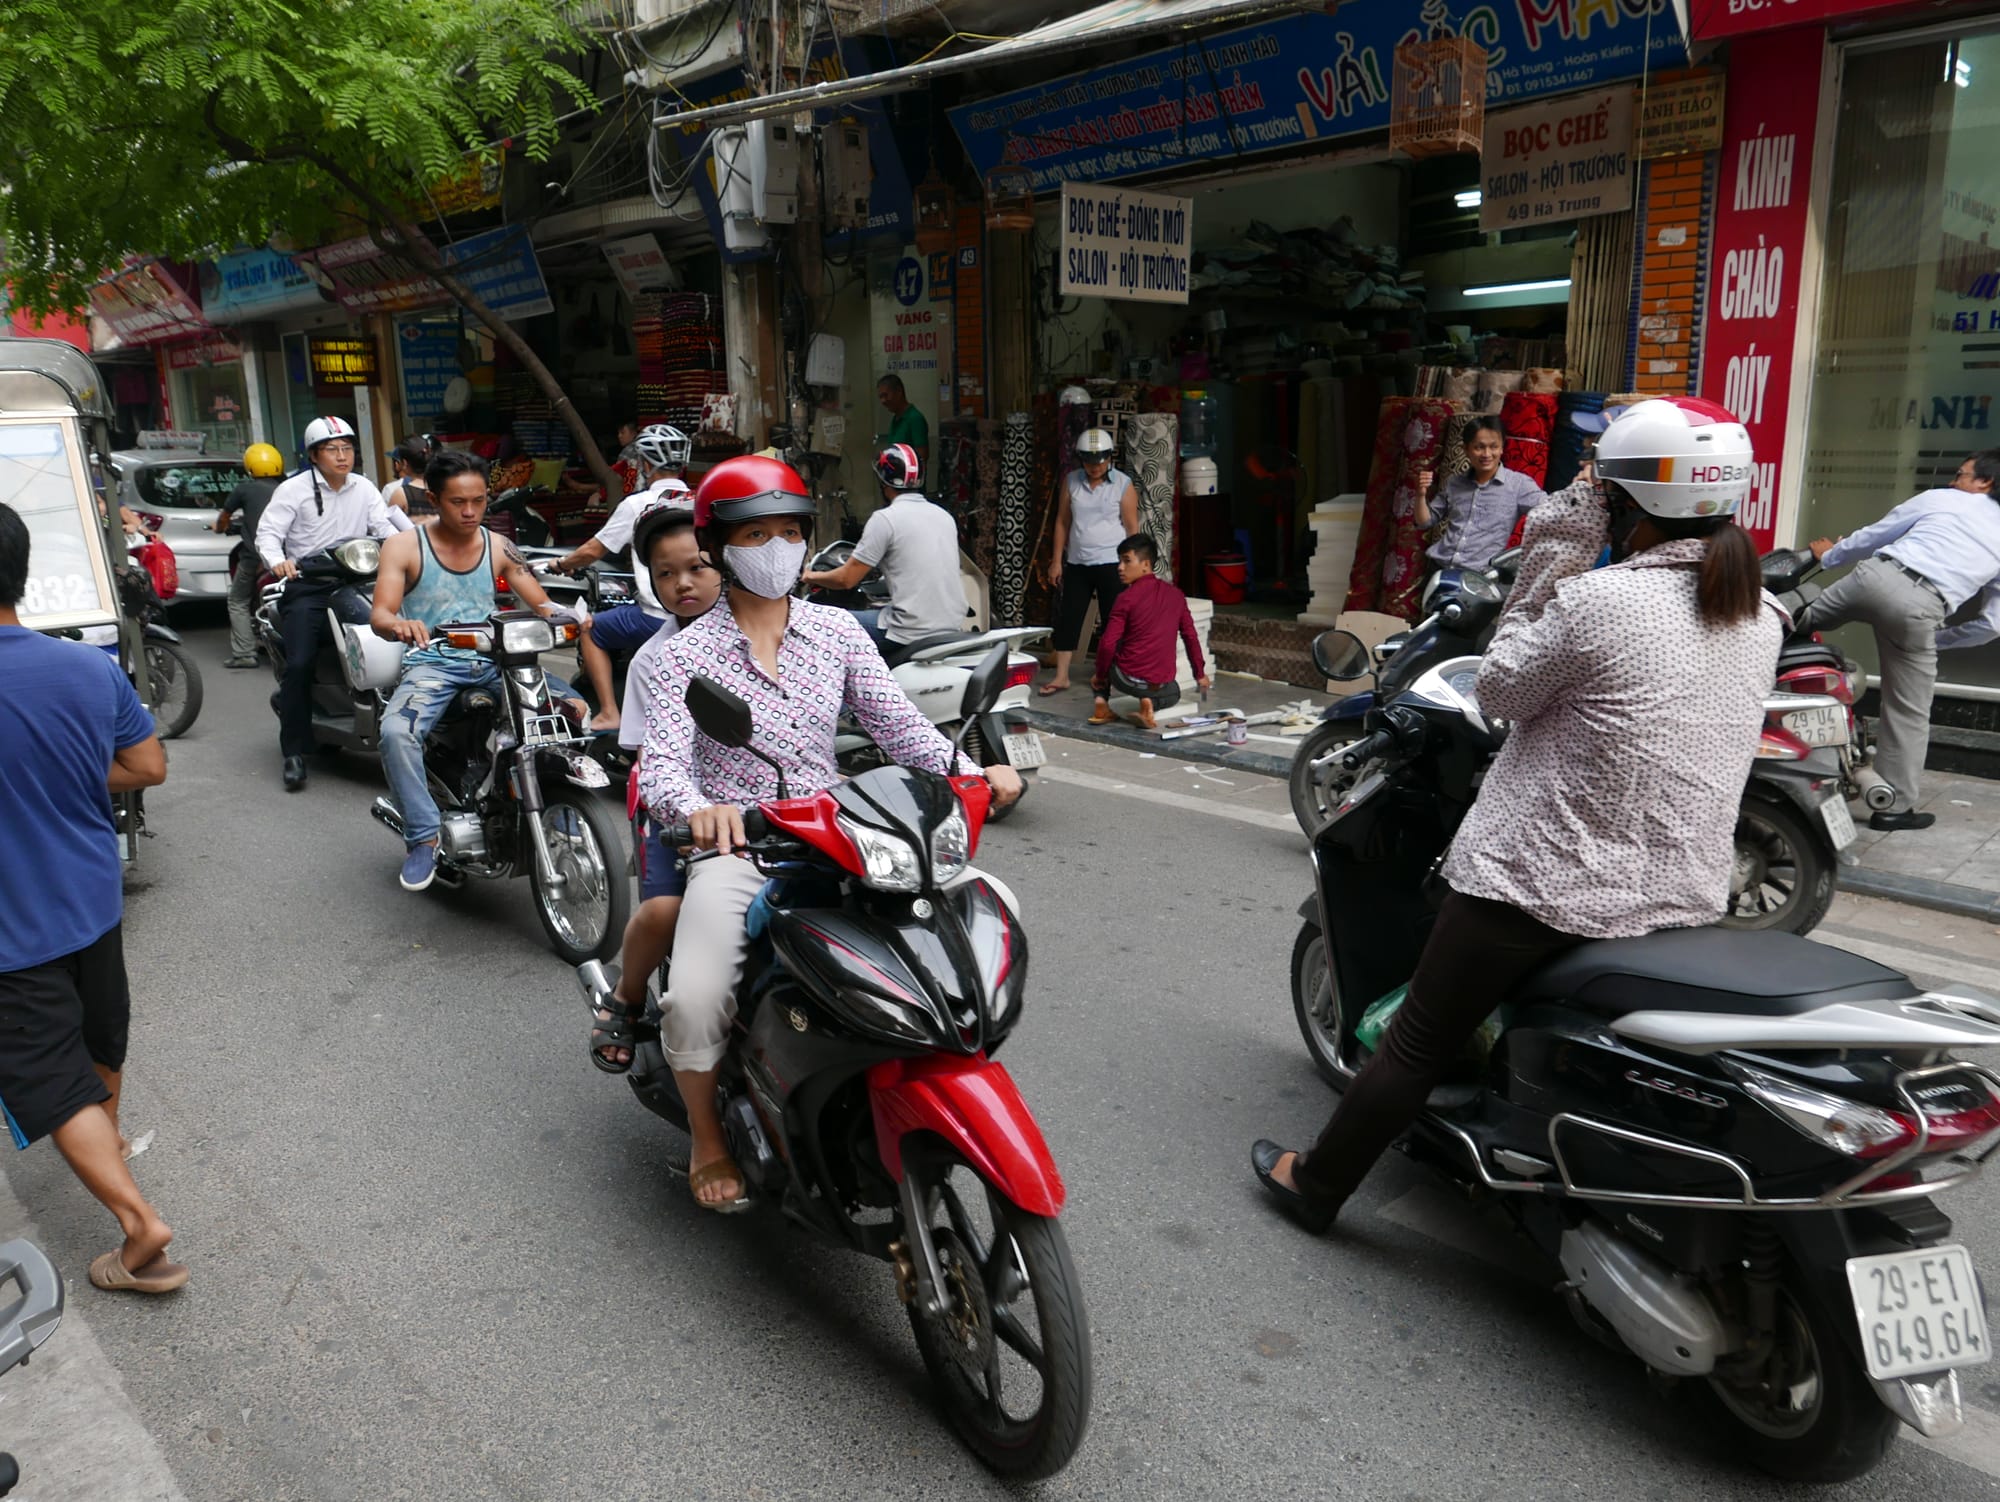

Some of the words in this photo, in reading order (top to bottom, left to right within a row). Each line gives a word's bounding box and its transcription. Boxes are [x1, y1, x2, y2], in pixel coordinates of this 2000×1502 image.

[1221, 41, 1251, 67] ANH
[1520, 60, 1553, 77] Trung
[1564, 51, 1598, 67] Hoàn
[1297, 32, 1389, 120] VẢI
[1138, 95, 1185, 134] THIỆU
[1185, 84, 1219, 123] SẢN
[1185, 132, 1221, 155] SALON
[1503, 123, 1550, 161] BỌC
[1556, 97, 1612, 148] GHẾ
[1487, 170, 1528, 200] SALON
[1540, 159, 1564, 195] HỘI
[1733, 122, 1796, 211] KÍNH
[1069, 197, 1094, 242] BỌC
[1163, 200, 1185, 245] MỚI
[1507, 203, 1529, 220] 49
[1534, 202, 1553, 217] Hà
[1558, 196, 1601, 214] Trung
[931, 256, 950, 281] 47
[961, 250, 975, 265] 49
[1069, 248, 1108, 285] SALON
[1120, 246, 1139, 294] HỘI
[1143, 247, 1187, 292] TRƯỜNG
[896, 266, 919, 297] 47
[1720, 234, 1784, 320] CHÀO
[1955, 312, 1979, 331] 51
[884, 335, 904, 353] GIA
[1791, 708, 1835, 729] 29-U4
[1915, 1083, 1973, 1099] HONDA
[1870, 1257, 1959, 1313] 29-E1
[1872, 1307, 1980, 1367] 649.64
